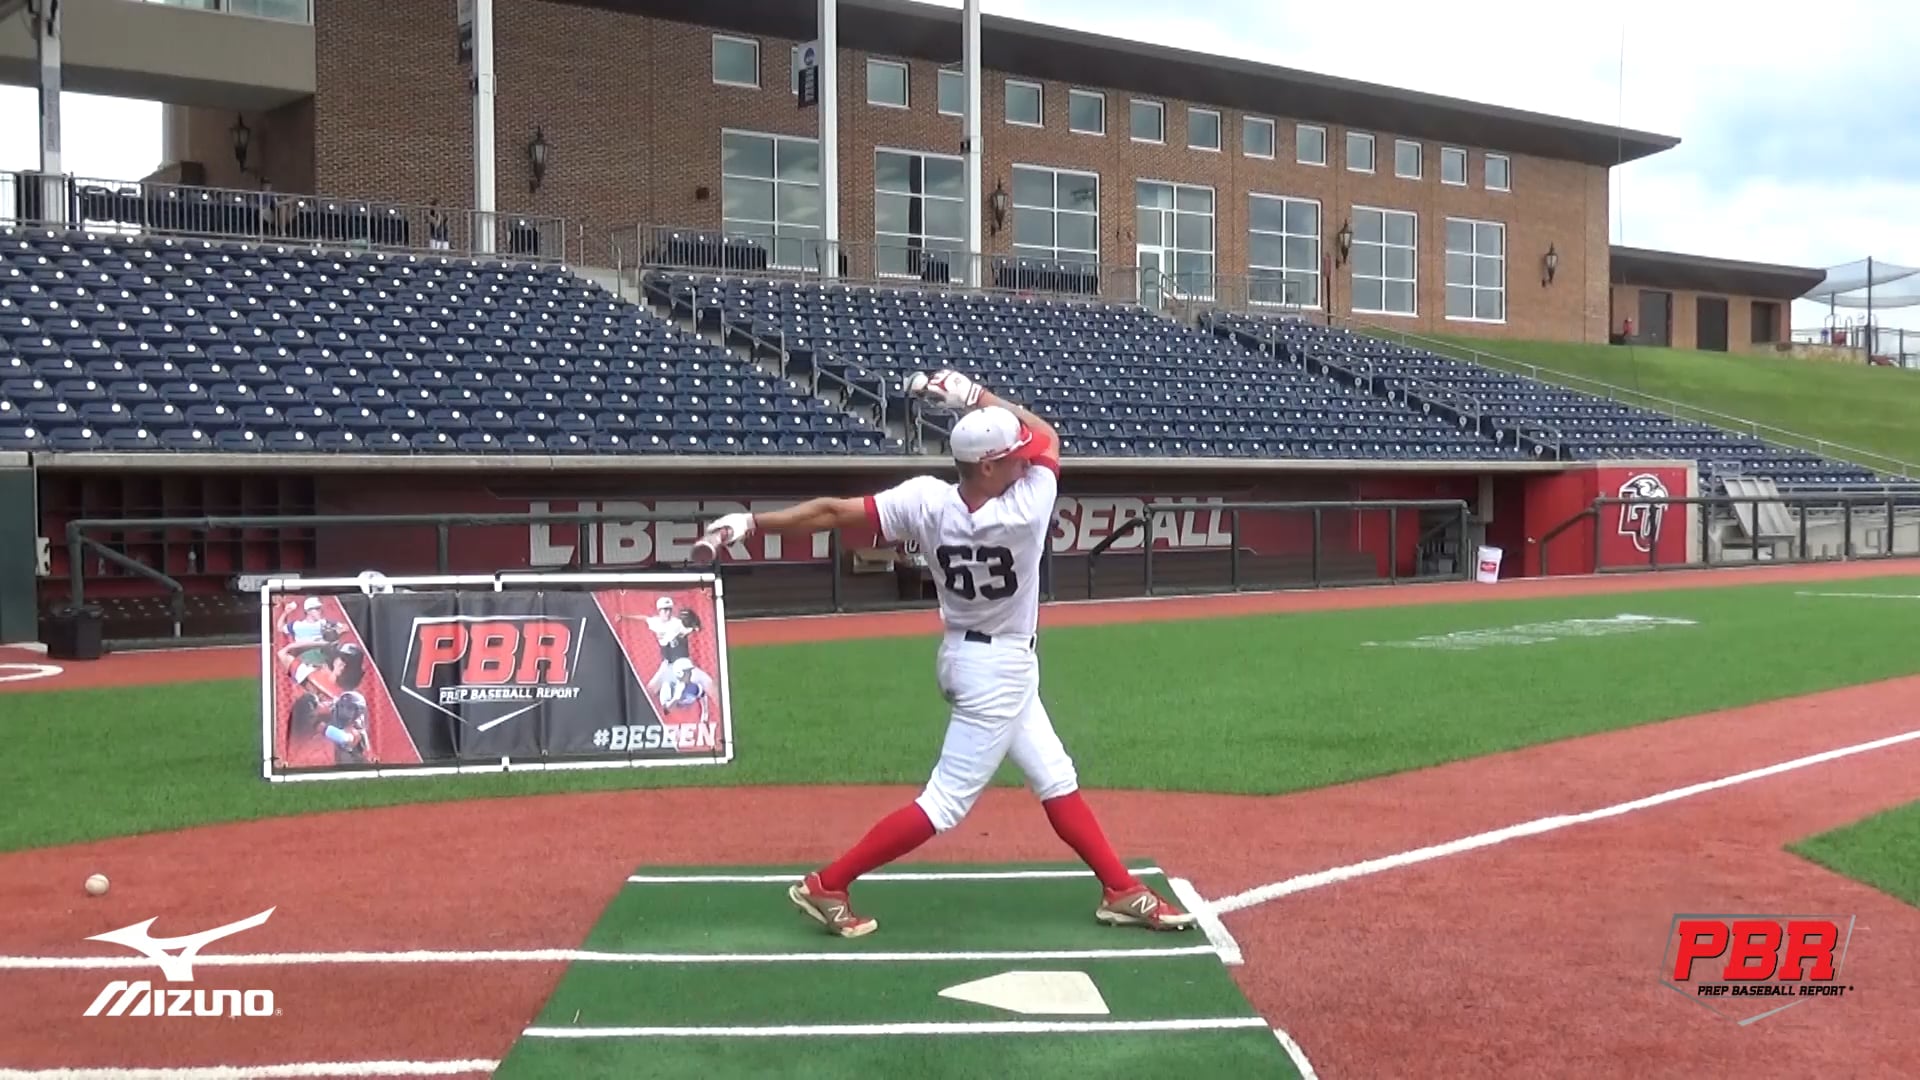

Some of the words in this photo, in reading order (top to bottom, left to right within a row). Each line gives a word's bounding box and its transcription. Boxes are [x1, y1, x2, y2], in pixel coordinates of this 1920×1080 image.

[936, 545, 1018, 600] 63
[416, 623, 571, 688] PBR
[440, 690, 467, 704] PREP
[469, 688, 533, 701] BASEBALL
[536, 687, 580, 699] REPORT
[593, 721, 717, 751] #BESEEN
